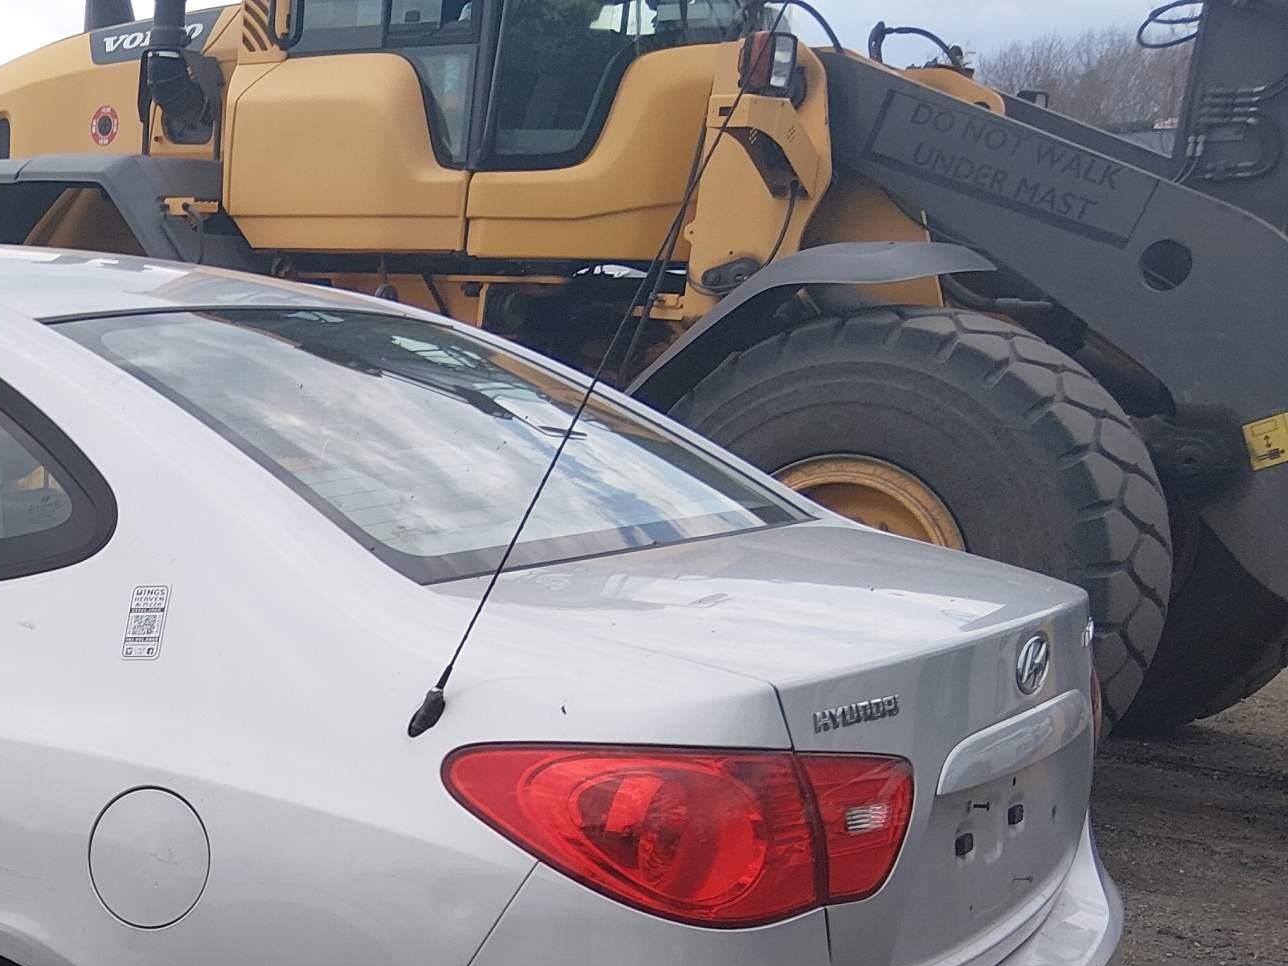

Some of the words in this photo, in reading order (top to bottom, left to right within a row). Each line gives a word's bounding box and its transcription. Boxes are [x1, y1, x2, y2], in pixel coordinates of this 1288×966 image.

[911, 102, 954, 133] DO
[961, 119, 1024, 153] NOT
[1036, 142, 1125, 191] WALK
[911, 143, 1009, 192] UNDER
[1012, 176, 1098, 220] MAST
[136, 588, 166, 596] WINGS
